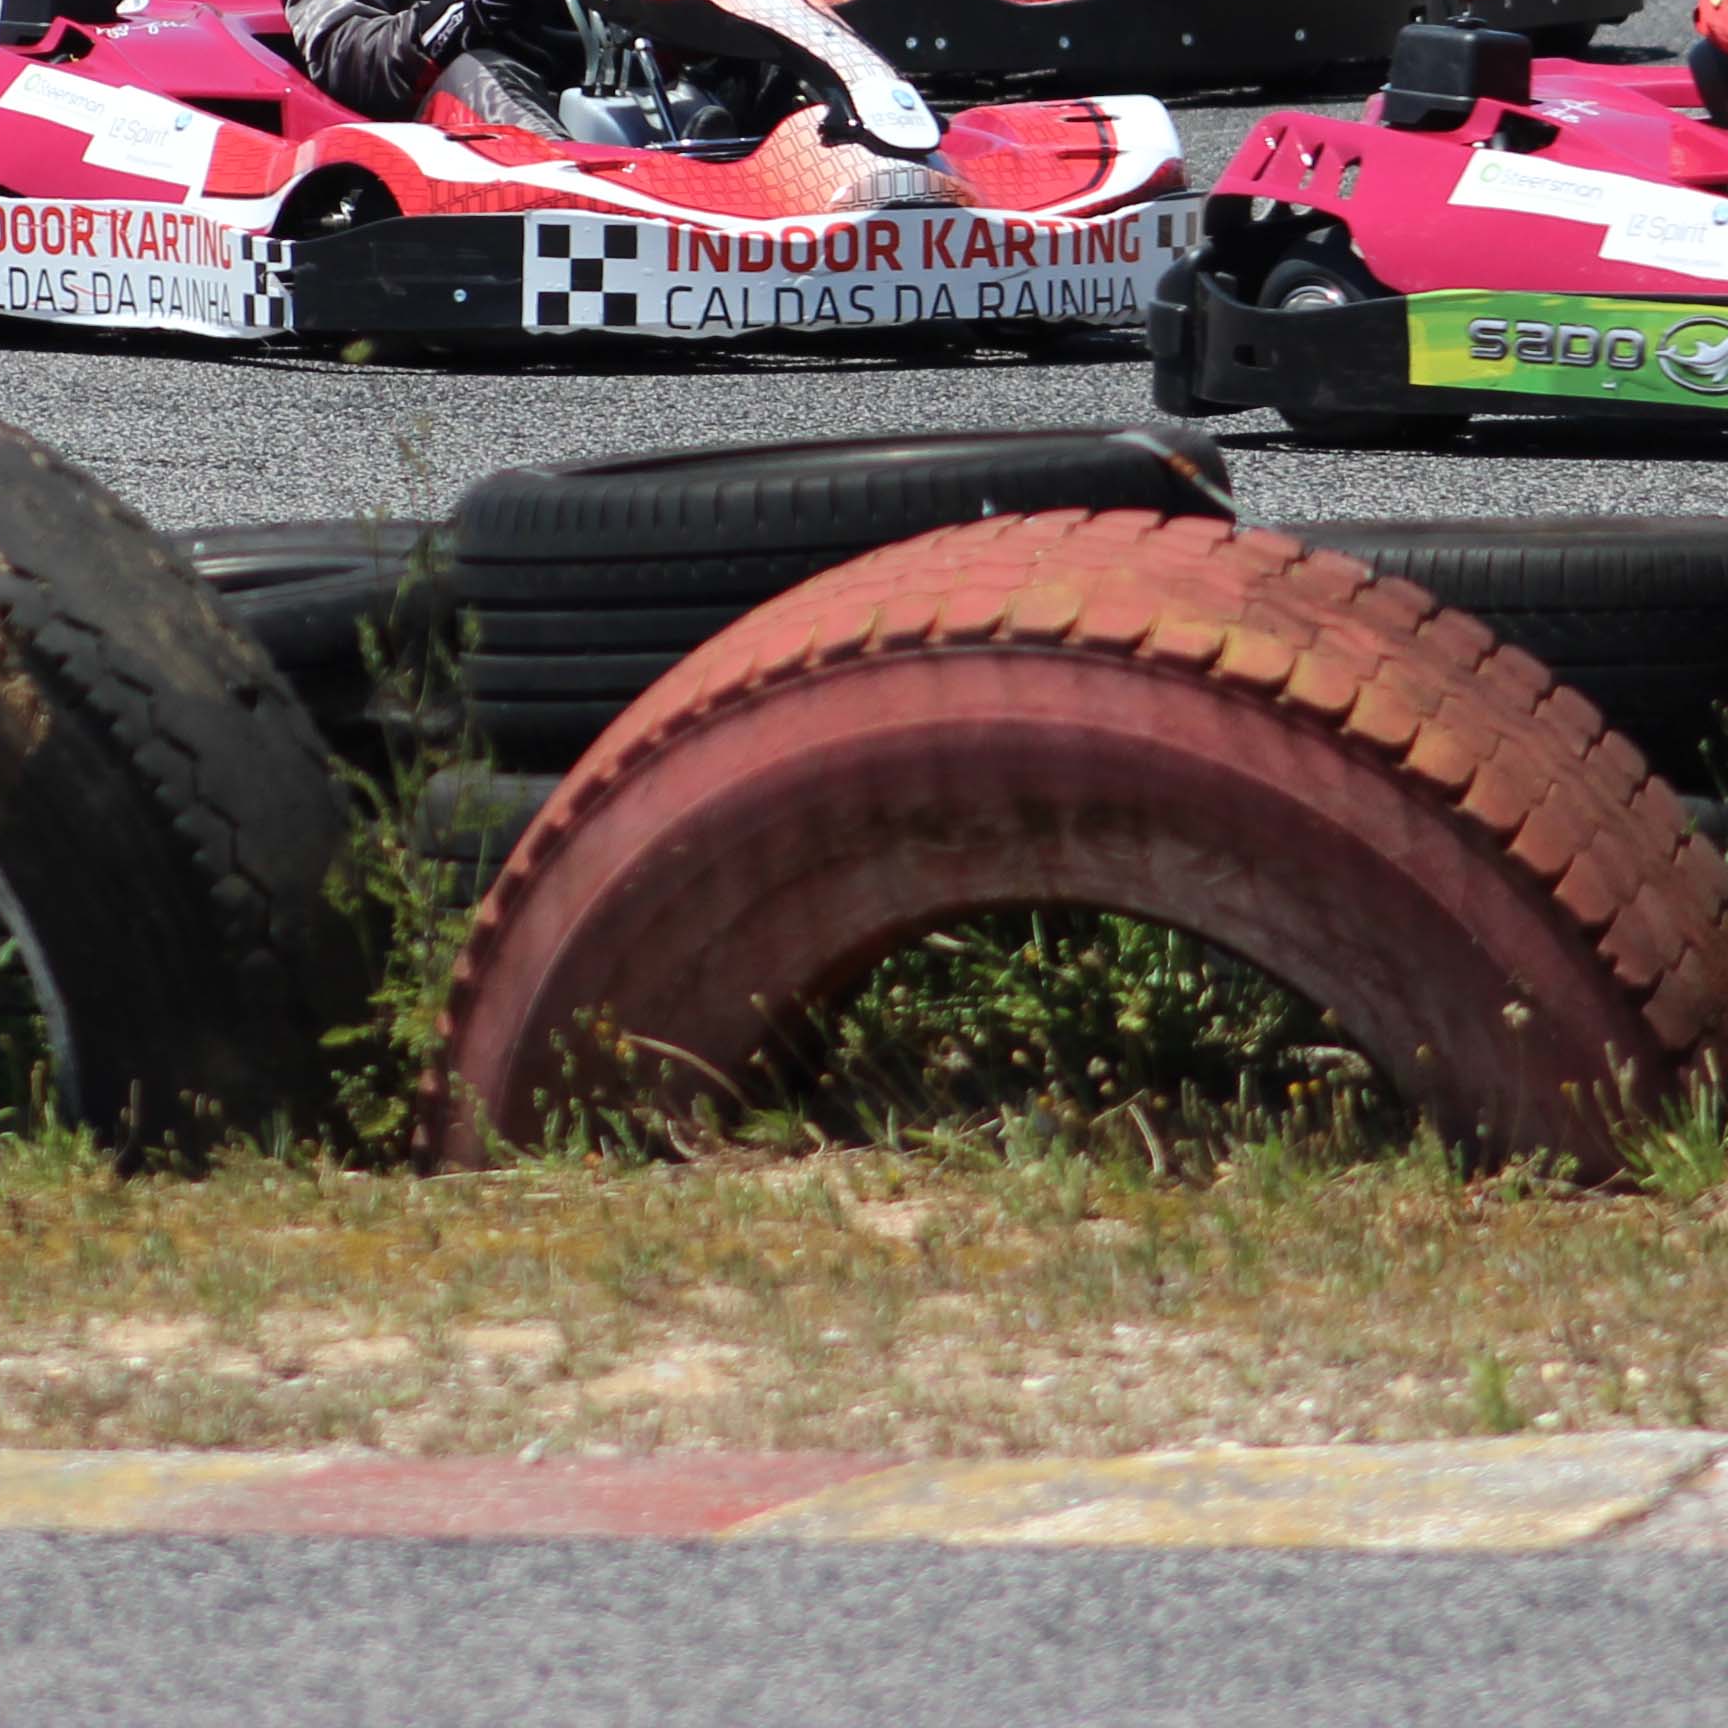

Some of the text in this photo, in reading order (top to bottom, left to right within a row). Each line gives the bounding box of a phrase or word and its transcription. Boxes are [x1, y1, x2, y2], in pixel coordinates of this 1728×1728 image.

[108, 208, 233, 270] KARTING
[665, 212, 1141, 274] INDOOR KARTING
[91, 271, 139, 316] DA
[147, 274, 235, 328] RAINHA
[665, 276, 1140, 331] CALDAS DA RAINHA
